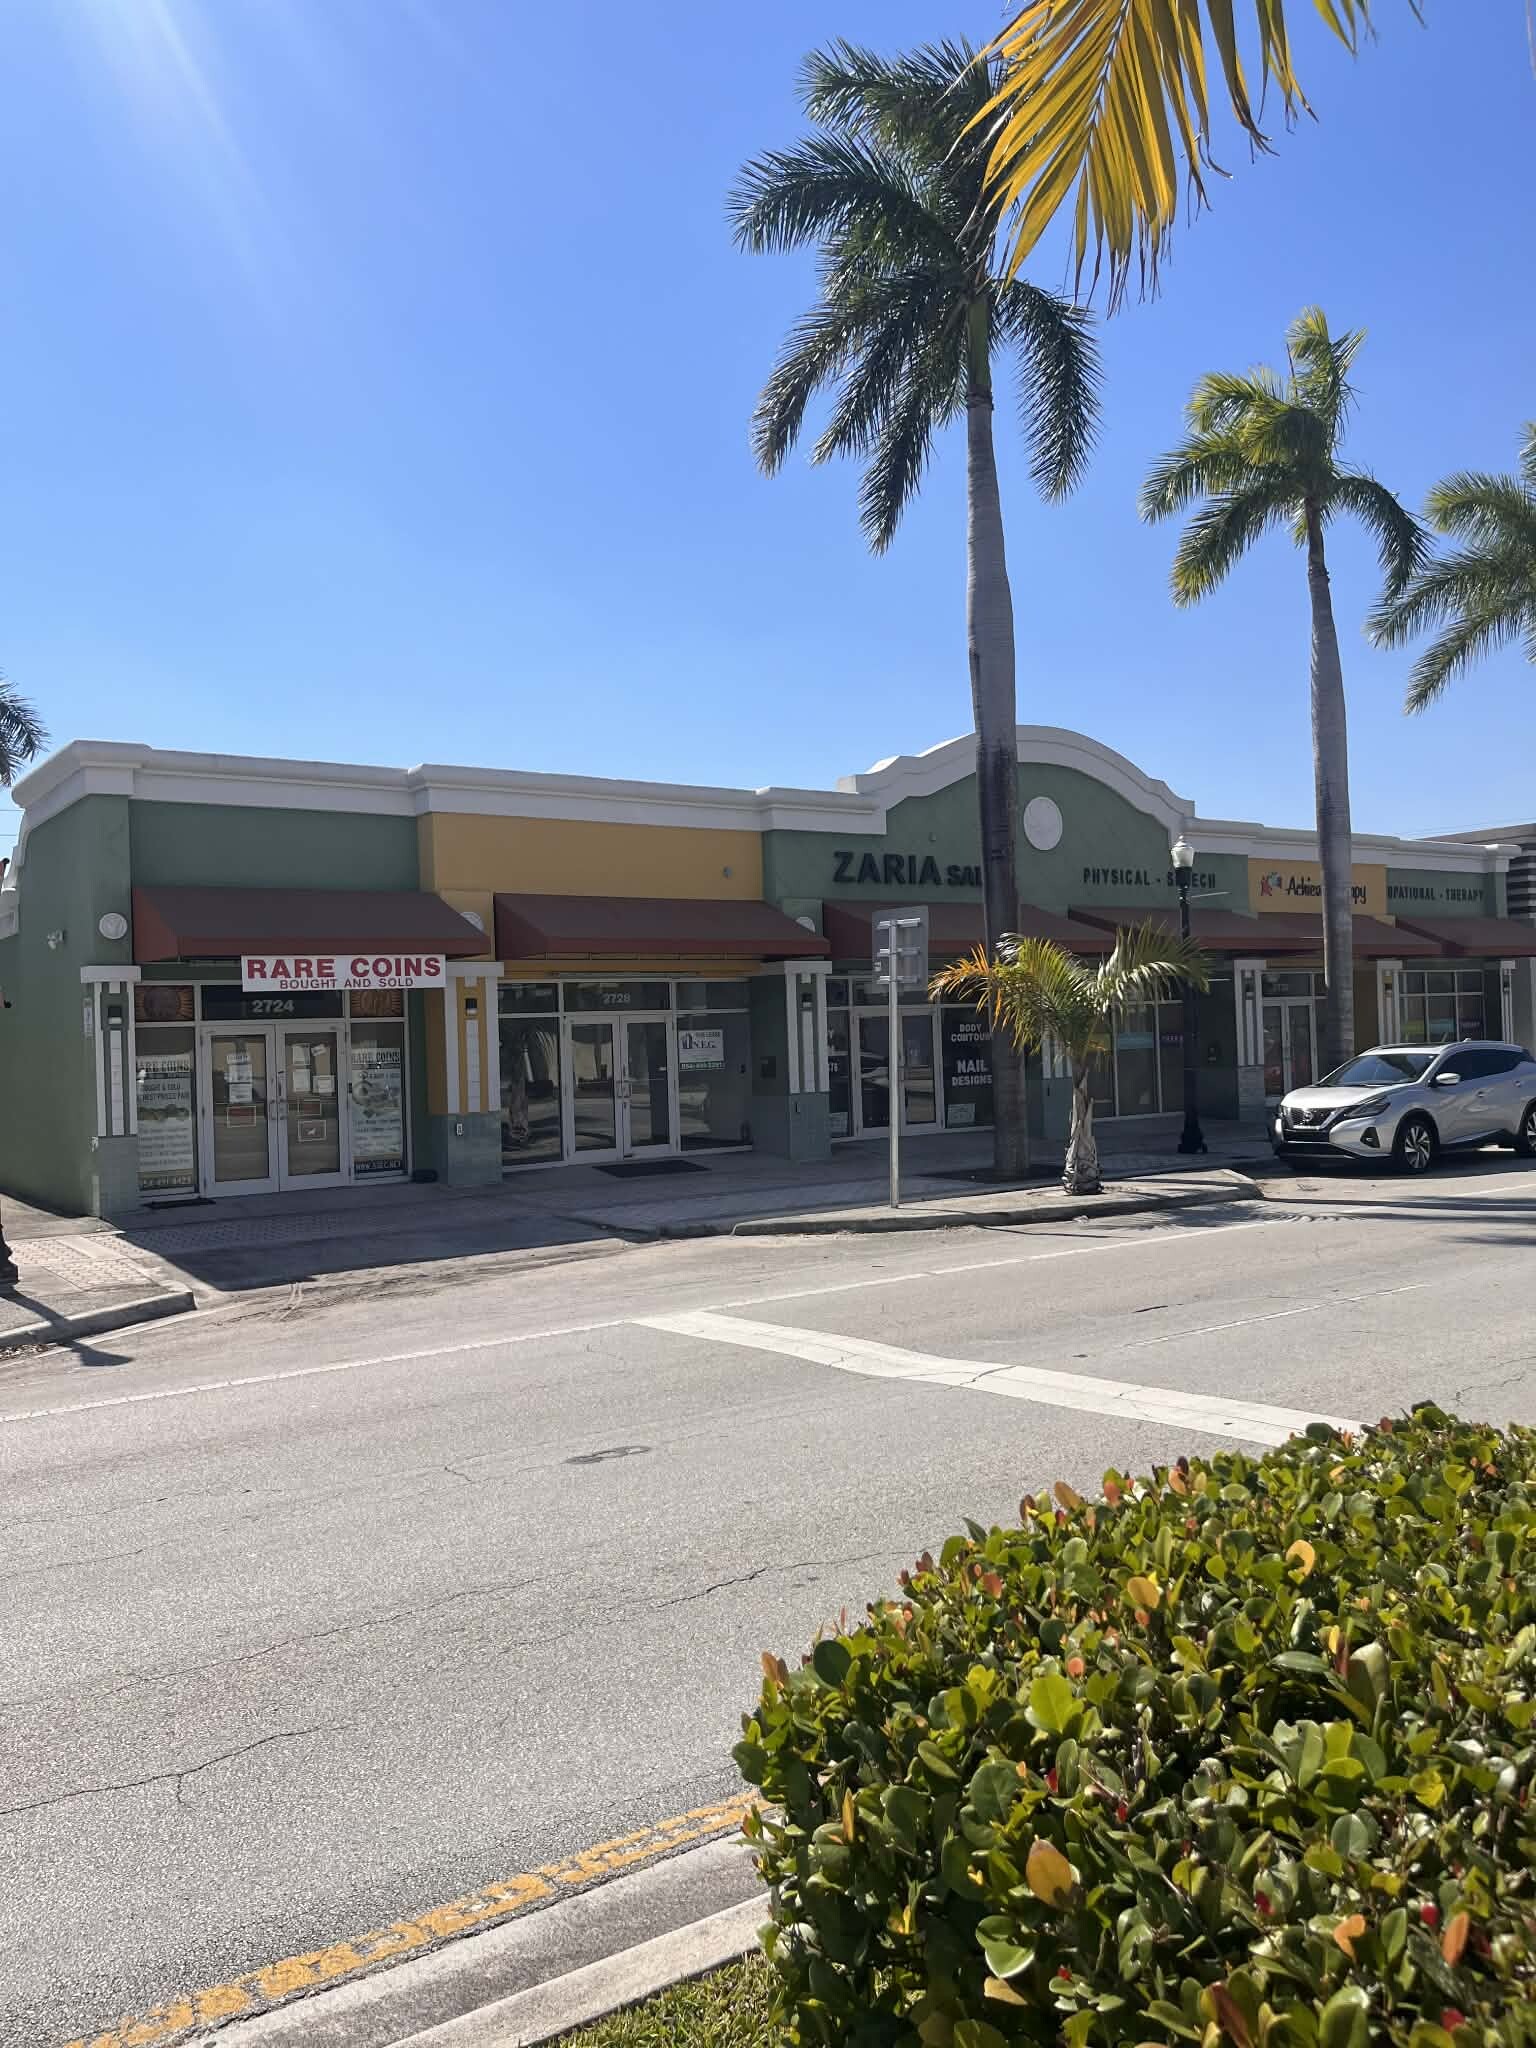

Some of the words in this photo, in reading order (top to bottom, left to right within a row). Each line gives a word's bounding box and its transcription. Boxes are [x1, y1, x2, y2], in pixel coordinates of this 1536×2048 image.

[833, 851, 943, 886] ZARIA
[946, 864, 983, 887] SAL
[1083, 866, 1150, 886] PHYSICAL
[1167, 871, 1216, 888] SECH
[1445, 887, 1484, 902] THERAPY
[247, 958, 335, 979] RARE
[350, 957, 441, 978] COINS
[279, 978, 338, 990] BOUGHT
[344, 978, 371, 988] AND
[379, 977, 414, 988] SOLD
[602, 992, 631, 1005] 2728
[252, 999, 295, 1013] 2724
[959, 1023, 982, 1033] BODY
[376, 1051, 400, 1062] COINS
[957, 1059, 989, 1073] NAIL
[951, 1074, 992, 1086] DESIGNS
